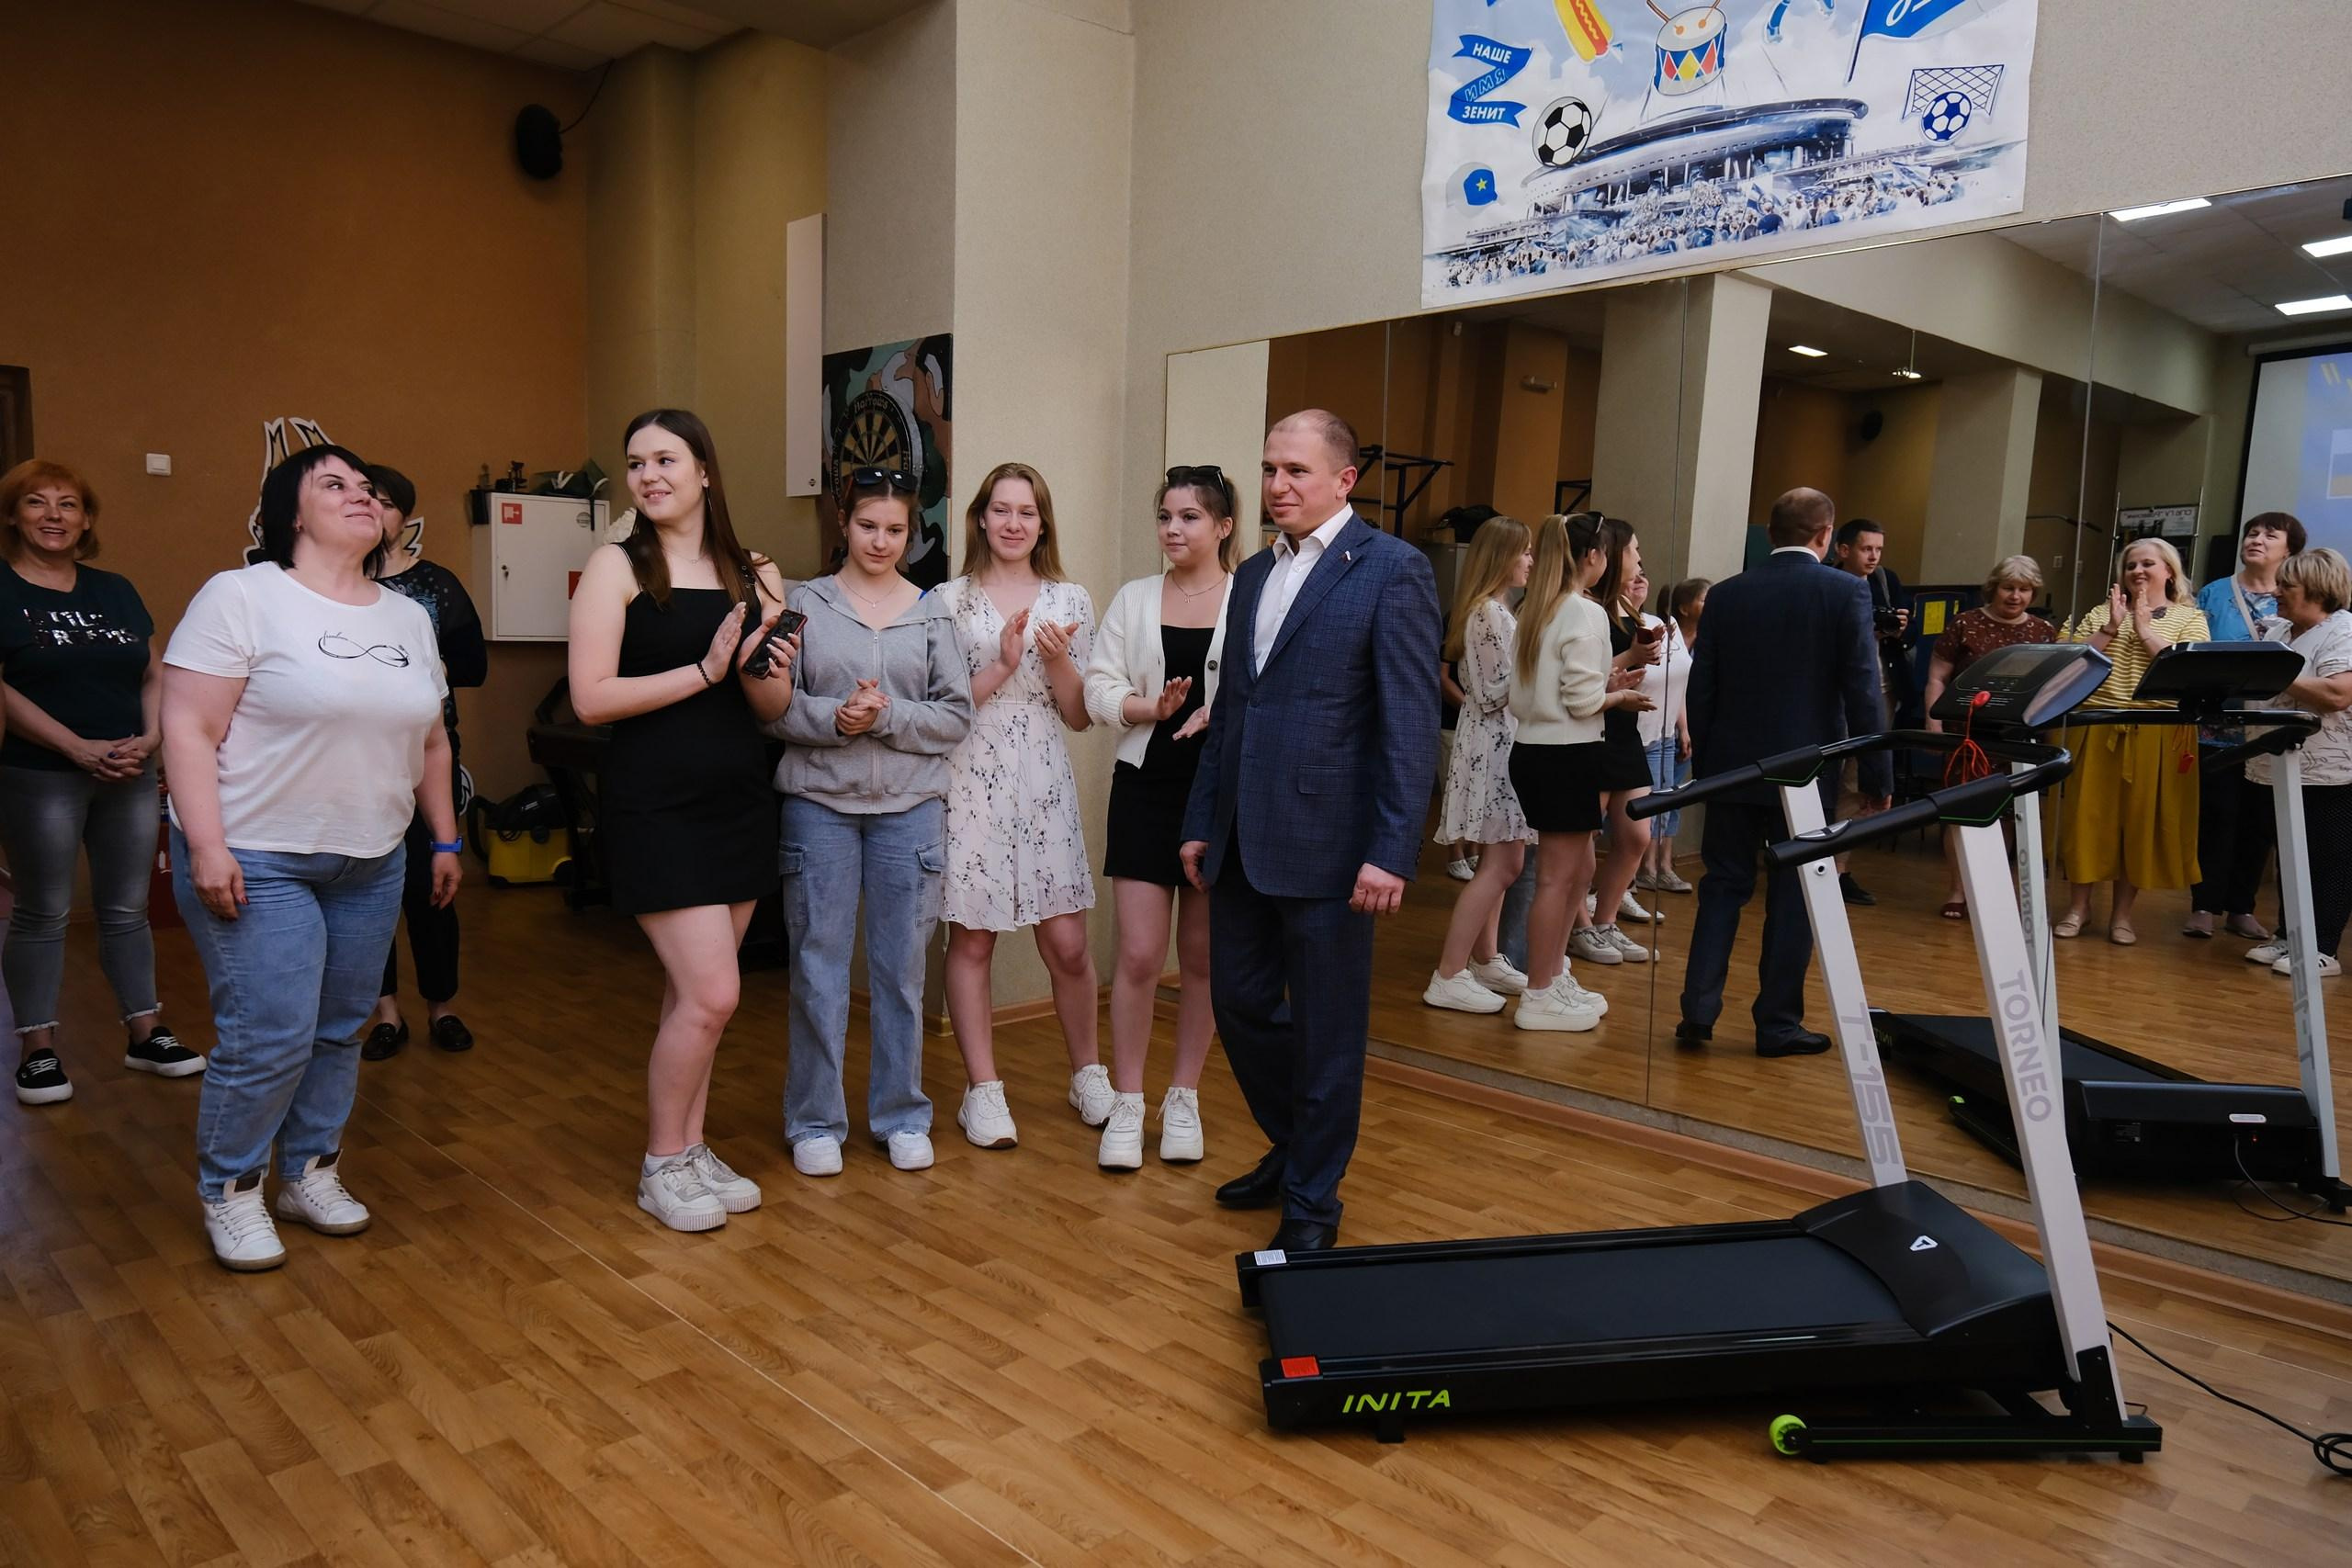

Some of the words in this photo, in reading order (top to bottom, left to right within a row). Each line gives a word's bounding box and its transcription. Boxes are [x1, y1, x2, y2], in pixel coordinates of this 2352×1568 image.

[1472, 43, 1512, 64] НАШЕ
[1464, 67, 1506, 102] ИМЯ
[1462, 105, 1506, 119] ЗЕНИТ
[1998, 969, 2052, 1122] TORNEO
[1839, 1002, 1901, 1166] T-155
[1342, 1388, 1451, 1414] INITA
